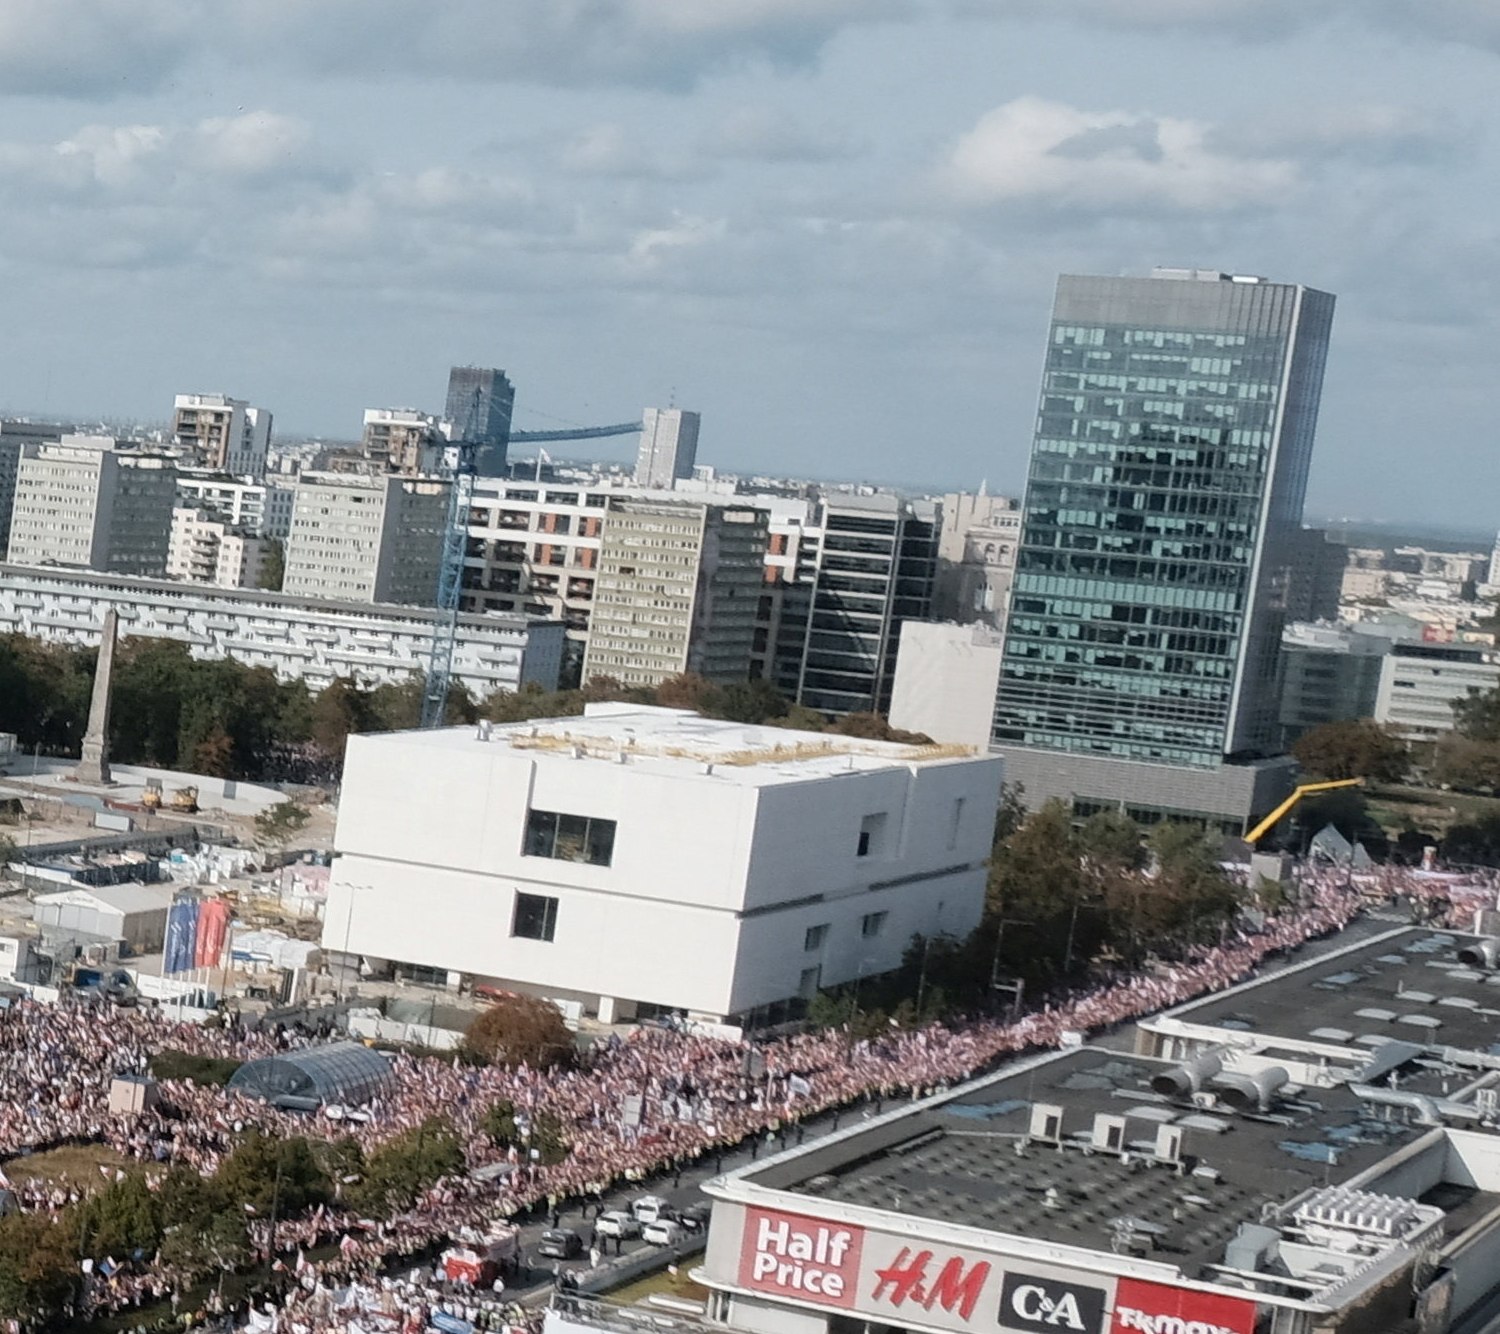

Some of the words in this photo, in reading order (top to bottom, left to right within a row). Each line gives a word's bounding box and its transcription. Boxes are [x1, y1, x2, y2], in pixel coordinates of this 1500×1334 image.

[757, 1217, 852, 1267] Half
[752, 1250, 845, 1298] Price
[871, 1246, 992, 1322] H&M
[1011, 1284, 1087, 1331] C&A
